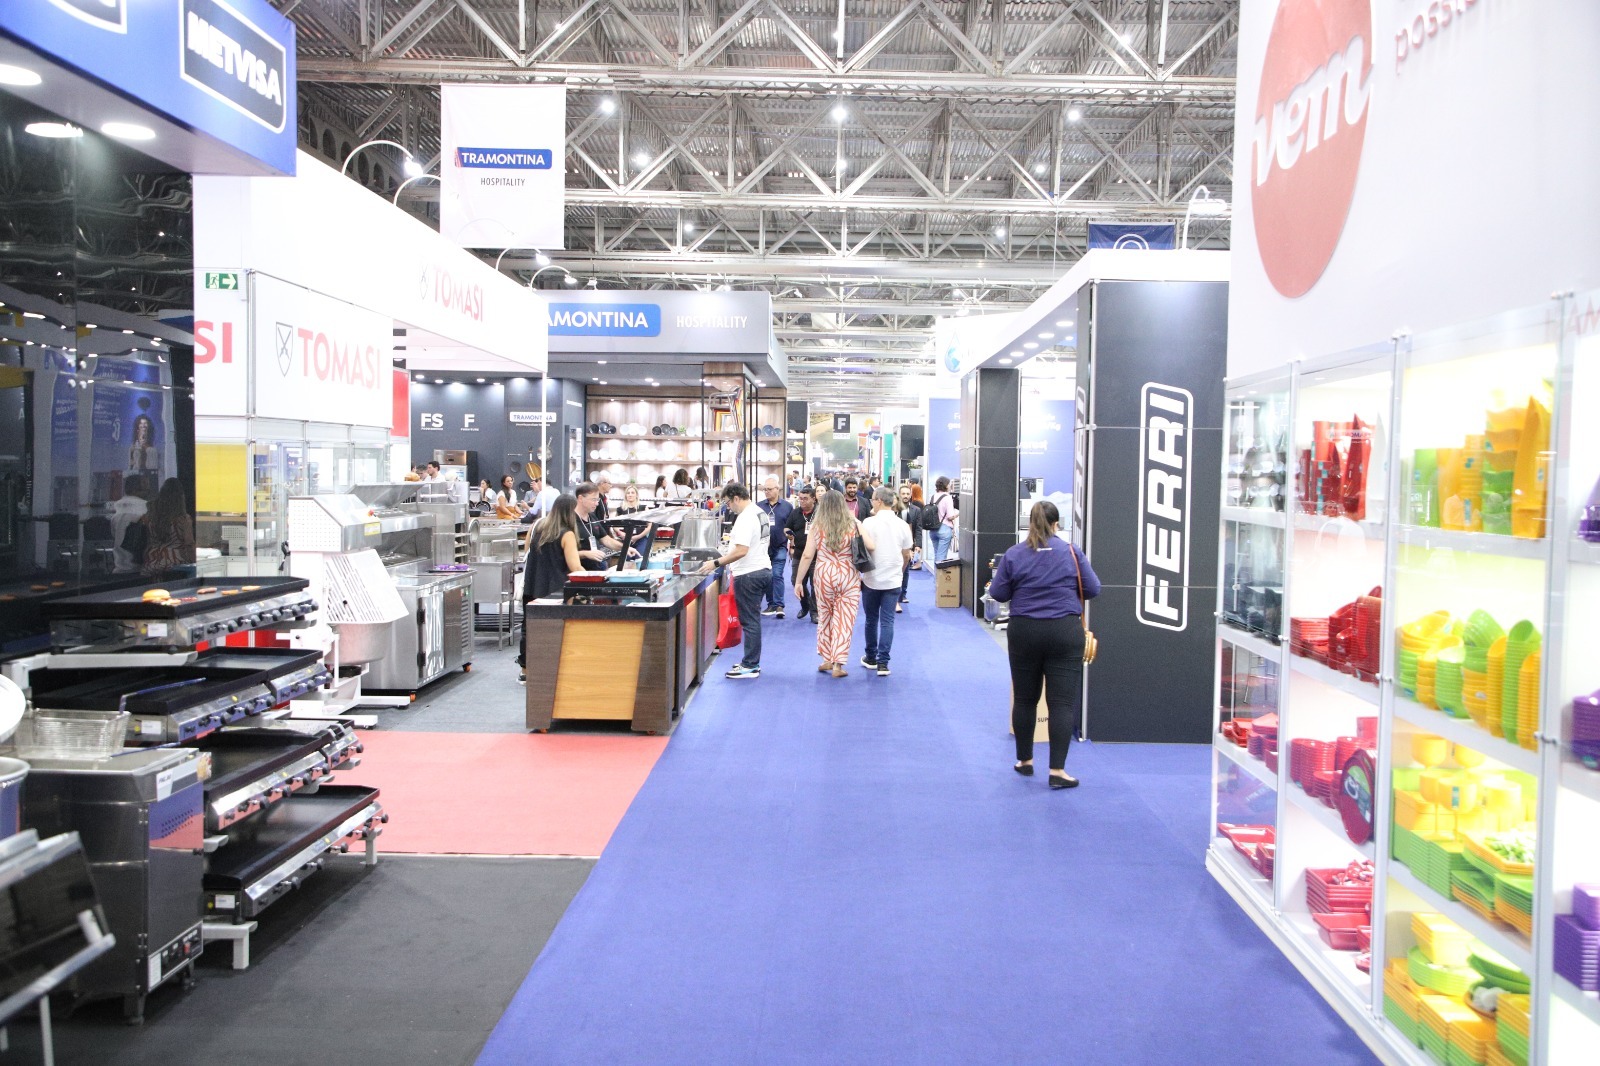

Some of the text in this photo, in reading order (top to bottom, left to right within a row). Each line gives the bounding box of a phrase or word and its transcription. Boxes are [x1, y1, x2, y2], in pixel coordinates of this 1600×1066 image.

[187, 10, 282, 106] METVISA
[461, 152, 545, 166] TRAMONTINA
[480, 177, 526, 187] HOSPITALITY
[433, 264, 483, 323] TOMASI
[676, 315, 748, 329] HOSPITALITY
[194, 320, 233, 364] SI
[298, 327, 381, 390] TOMASI
[420, 412, 444, 428] FS
[464, 413, 475, 428] F
[837, 417, 847, 430] F
[1144, 392, 1185, 621] FERRI
